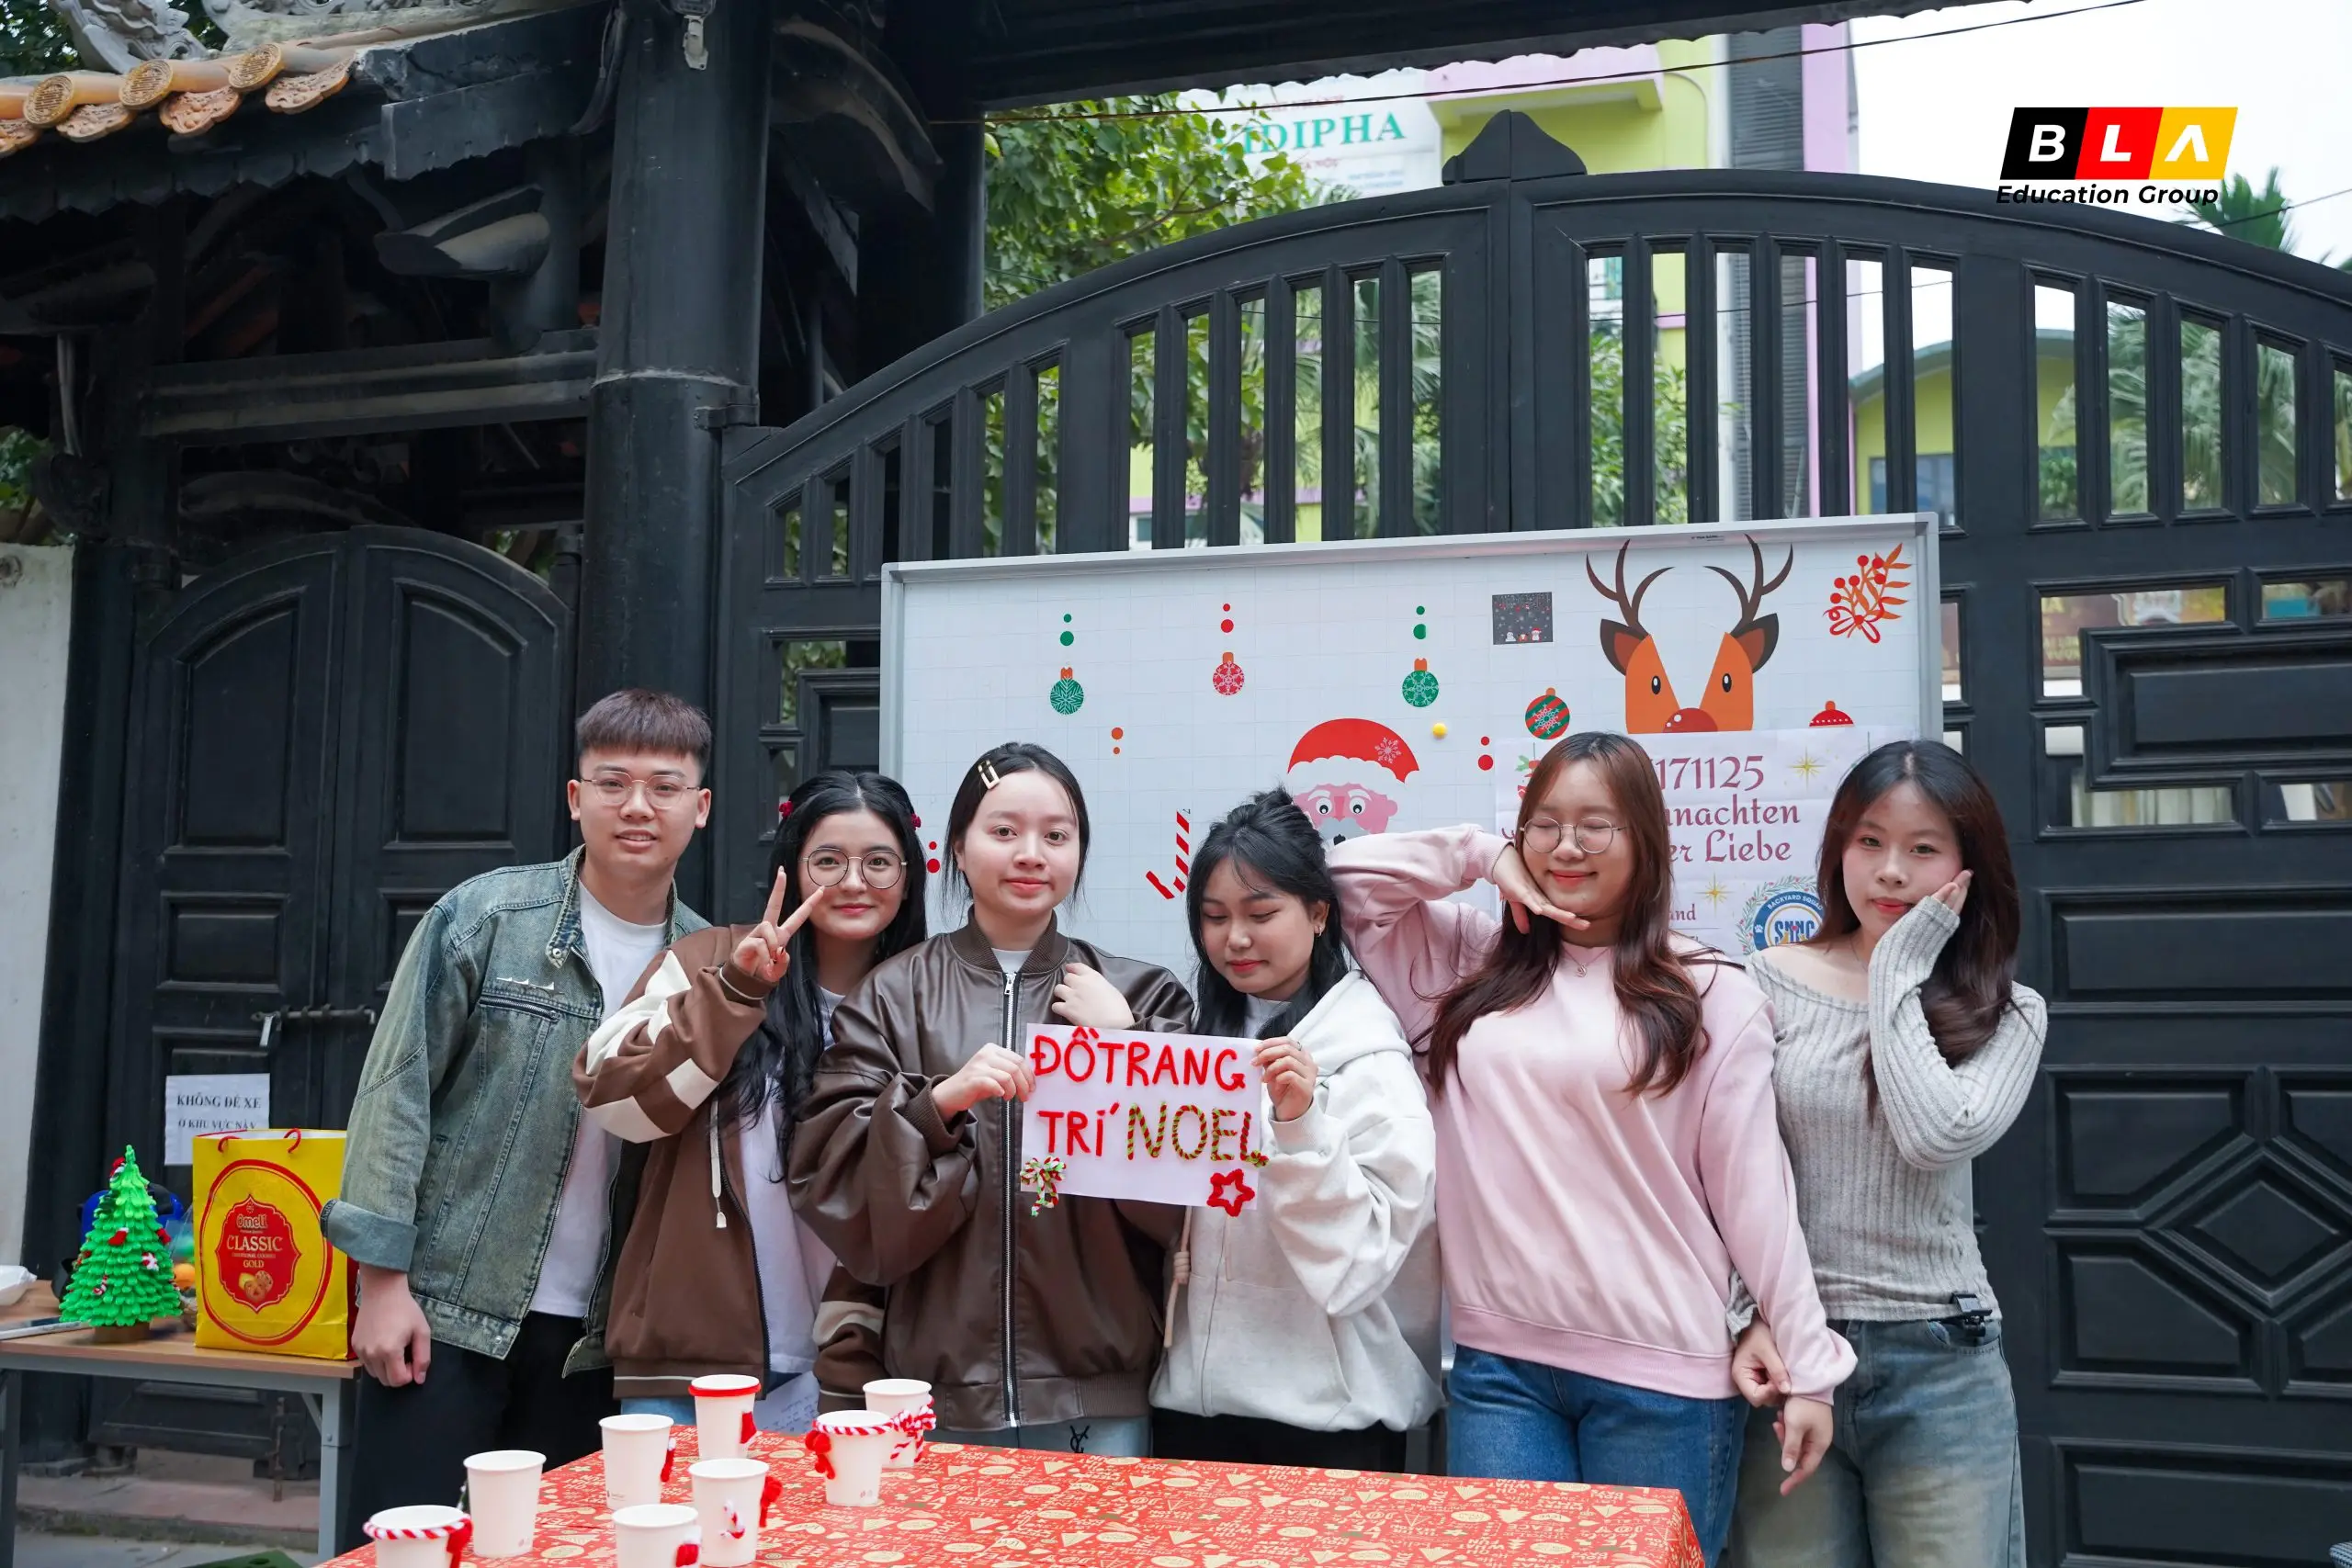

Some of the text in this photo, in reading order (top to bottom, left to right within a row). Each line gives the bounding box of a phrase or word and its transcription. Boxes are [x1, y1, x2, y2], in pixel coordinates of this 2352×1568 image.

[1217, 111, 1406, 154] IDIPHA
[1651, 755, 1765, 792] 171125
[1668, 829, 1792, 863] er Liebe
[1767, 894, 1802, 910] BACKYARD
[177, 1091, 221, 1108] KHÔNG
[243, 1097, 262, 1109] XE
[1126, 1101, 1267, 1167] NOEL
[226, 1235, 283, 1251] CLASSIC
[243, 1259, 265, 1269] GOLD
